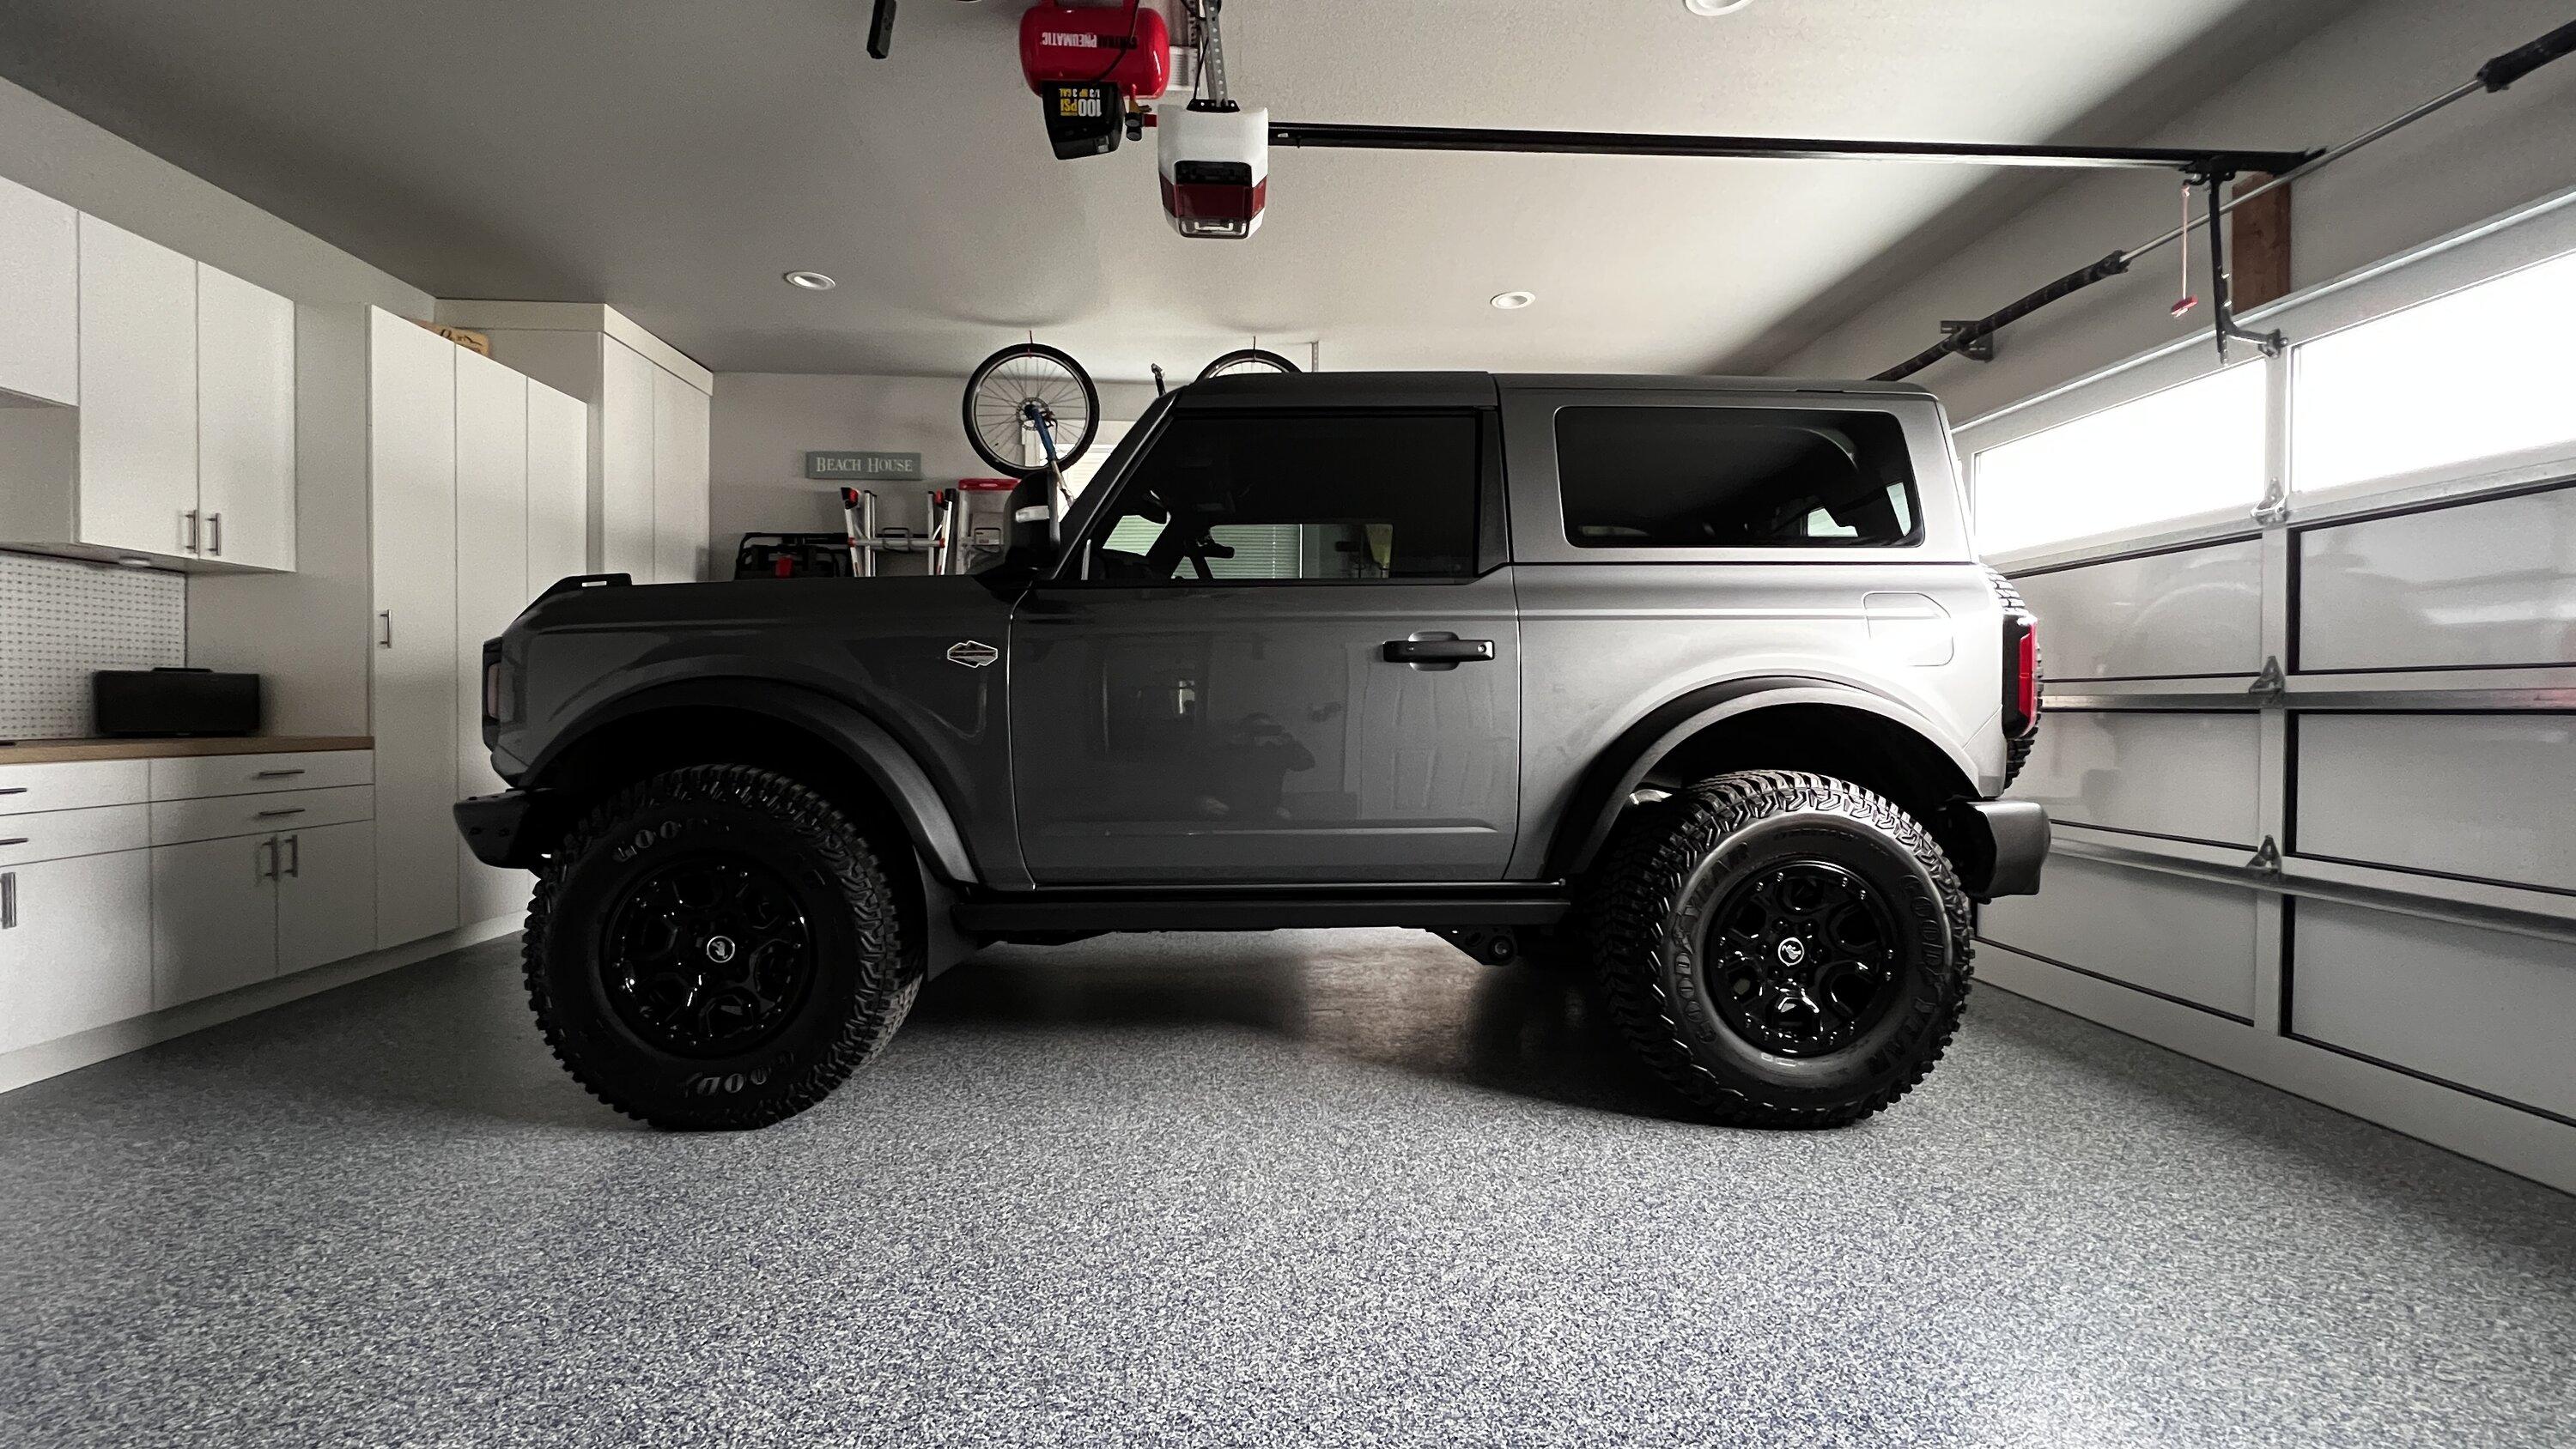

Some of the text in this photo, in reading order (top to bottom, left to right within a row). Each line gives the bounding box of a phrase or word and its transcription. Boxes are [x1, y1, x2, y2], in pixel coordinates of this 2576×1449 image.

[1042, 32, 1097, 48] PNEUMATIC
[1060, 98, 1103, 117] 100 PSI
[816, 457, 913, 473] BEACH HOUSE
